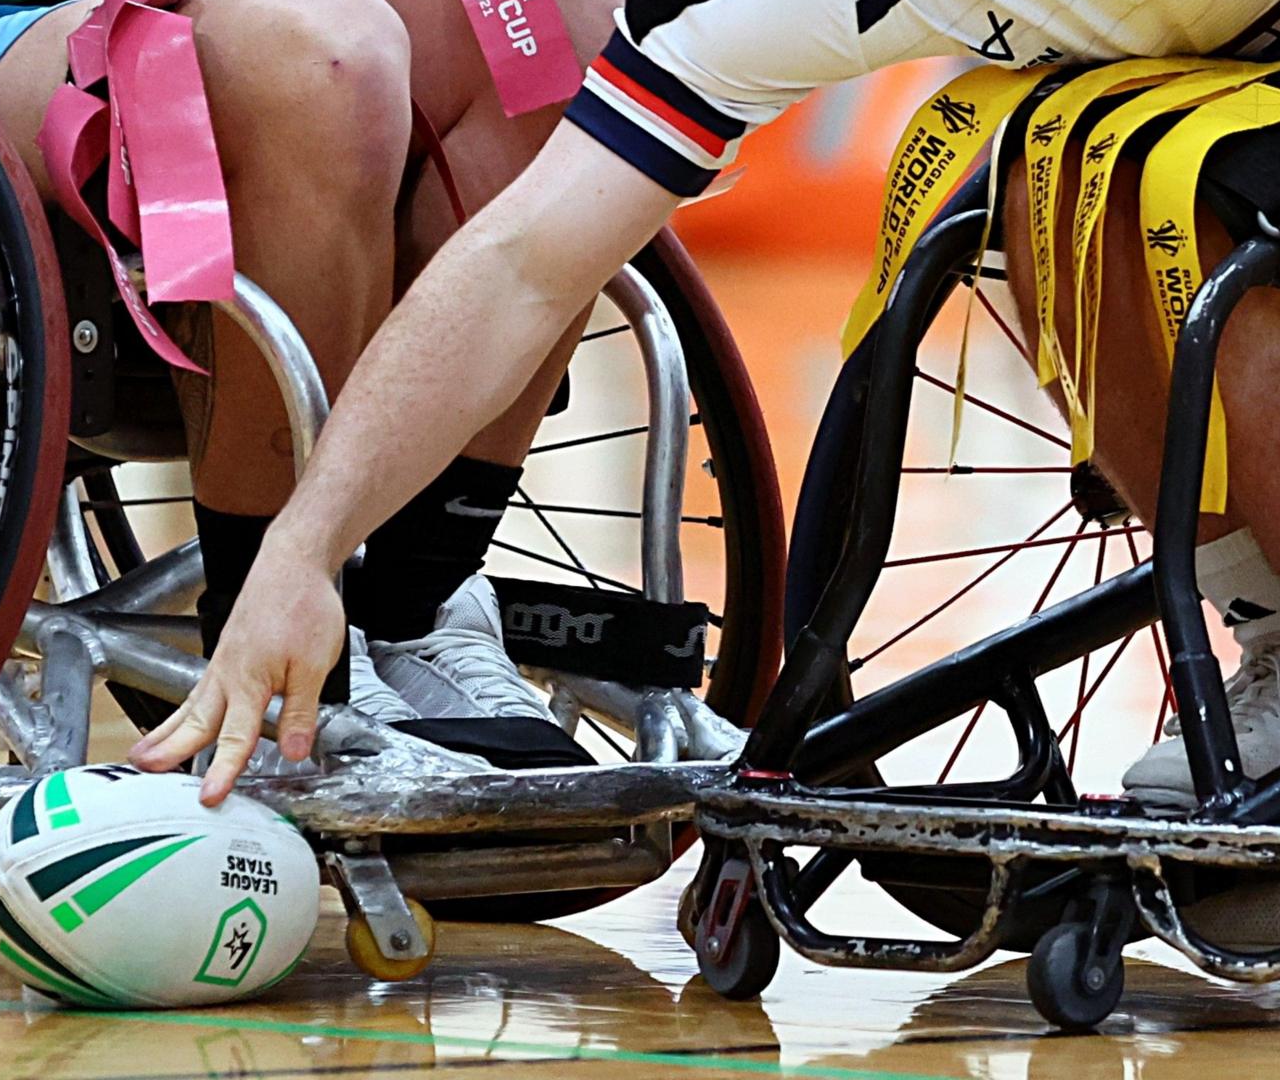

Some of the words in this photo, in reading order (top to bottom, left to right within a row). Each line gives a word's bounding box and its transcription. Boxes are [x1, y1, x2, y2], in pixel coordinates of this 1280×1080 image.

[888, 134, 947, 234] WORLD
[889, 126, 927, 189] ENGLAND
[920, 148, 956, 199] RUGBY
[894, 198, 922, 258] LEAGUE
[876, 239, 894, 296] CUP
[1155, 269, 1176, 338] ENGLAND
[220, 871, 278, 896] LEAGUE
[227, 855, 273, 876] STARS
